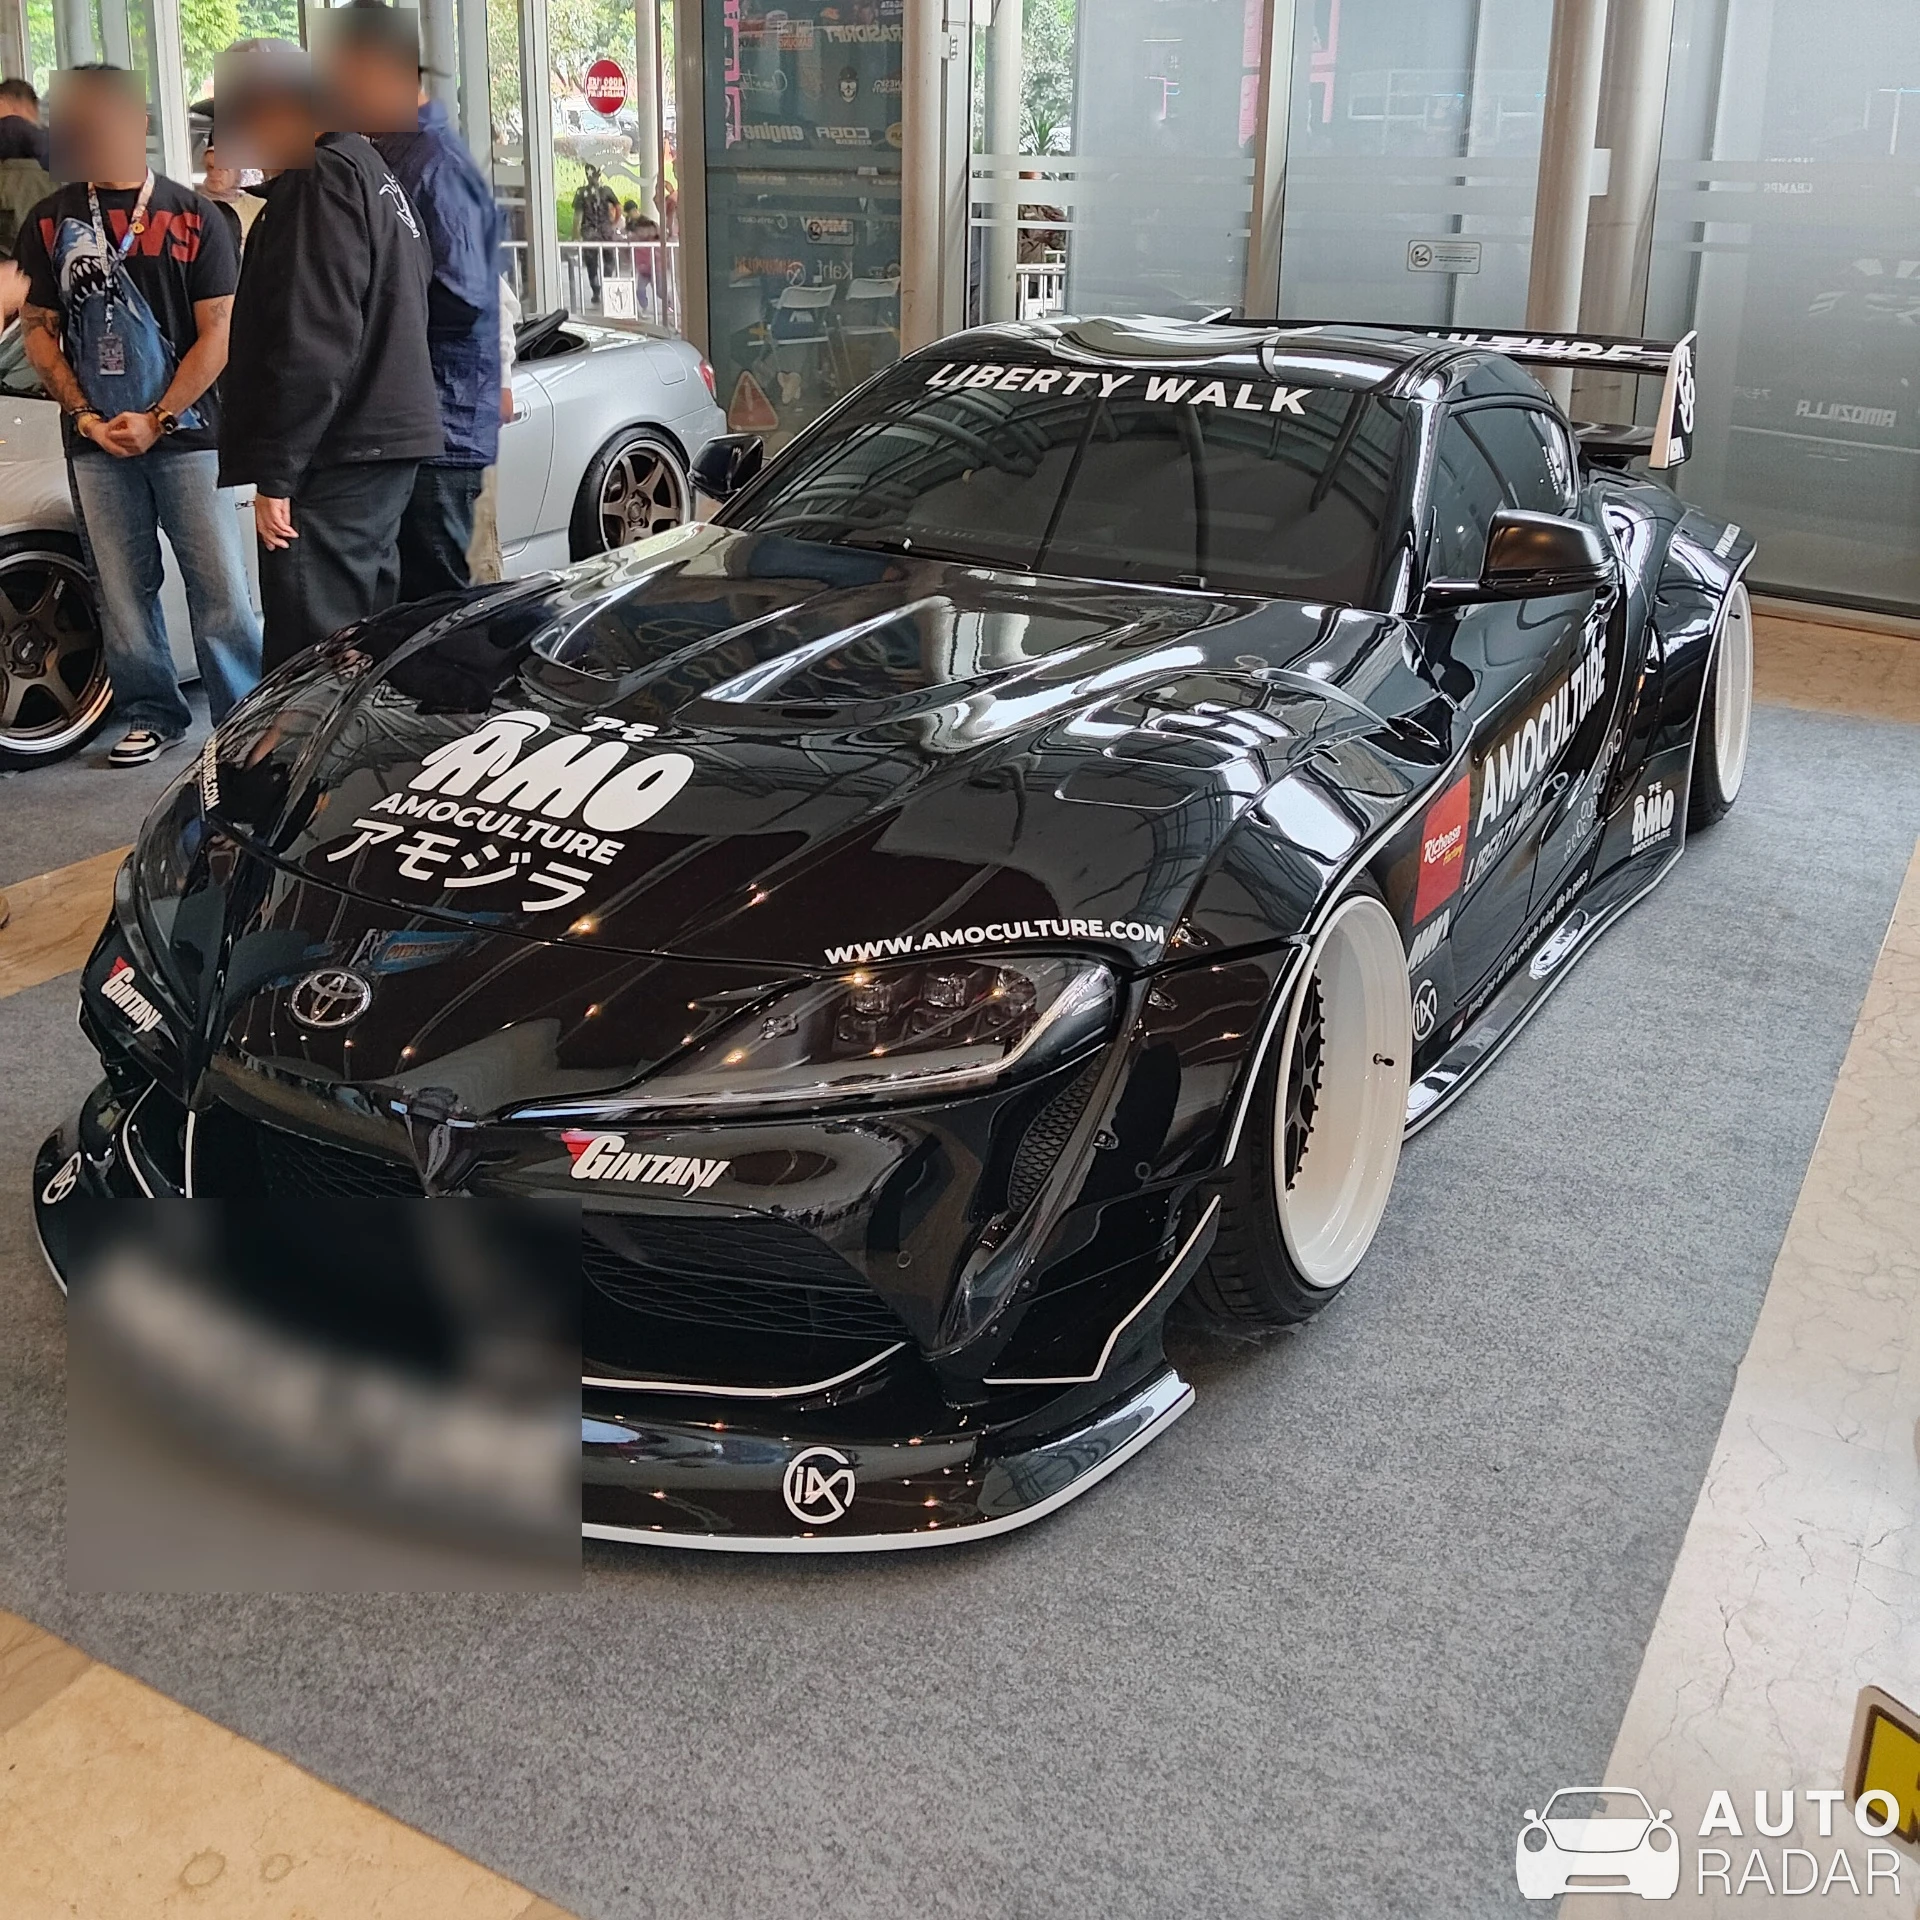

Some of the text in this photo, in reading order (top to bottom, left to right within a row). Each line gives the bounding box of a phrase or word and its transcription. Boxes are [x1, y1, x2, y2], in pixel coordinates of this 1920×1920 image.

[925, 363, 1313, 415] LIBERTY WALK
[581, 716, 659, 742] アモ
[1475, 634, 1606, 838] AMOCULTURE
[408, 710, 695, 832] AMO
[369, 793, 625, 865] AMOCULTURE
[1632, 789, 1674, 844] AMO
[327, 818, 593, 912] アモジラ
[824, 919, 1165, 965] WWW.AMOCULTURE.COM
[101, 966, 163, 1035] GINTANI
[571, 1135, 731, 1198] GINTANI
